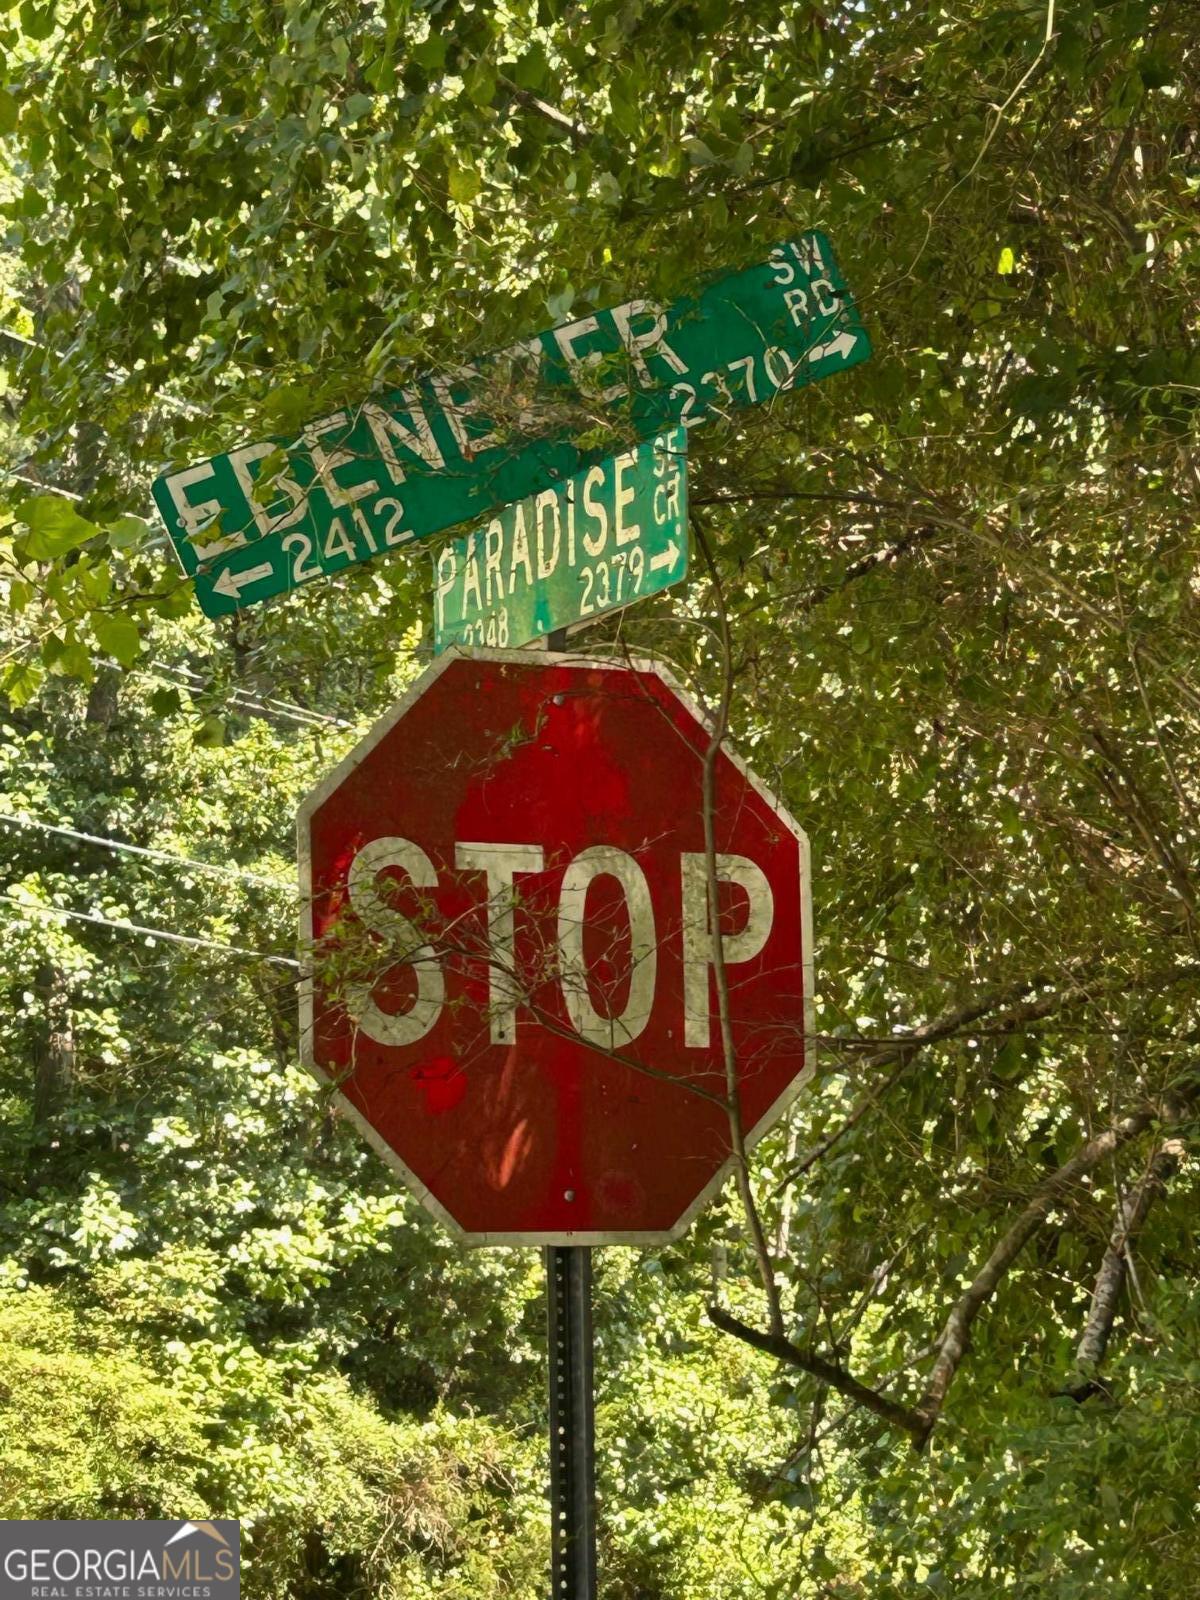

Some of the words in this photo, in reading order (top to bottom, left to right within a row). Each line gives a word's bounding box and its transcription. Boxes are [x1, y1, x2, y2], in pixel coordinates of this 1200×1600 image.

[768, 235, 825, 285] SW
[784, 279, 839, 328] RD
[653, 471, 681, 526] CR
[281, 497, 415, 583] 2412
[437, 447, 641, 631] PARADISE
[579, 546, 645, 616] 2379
[347, 836, 775, 1050] STOP
